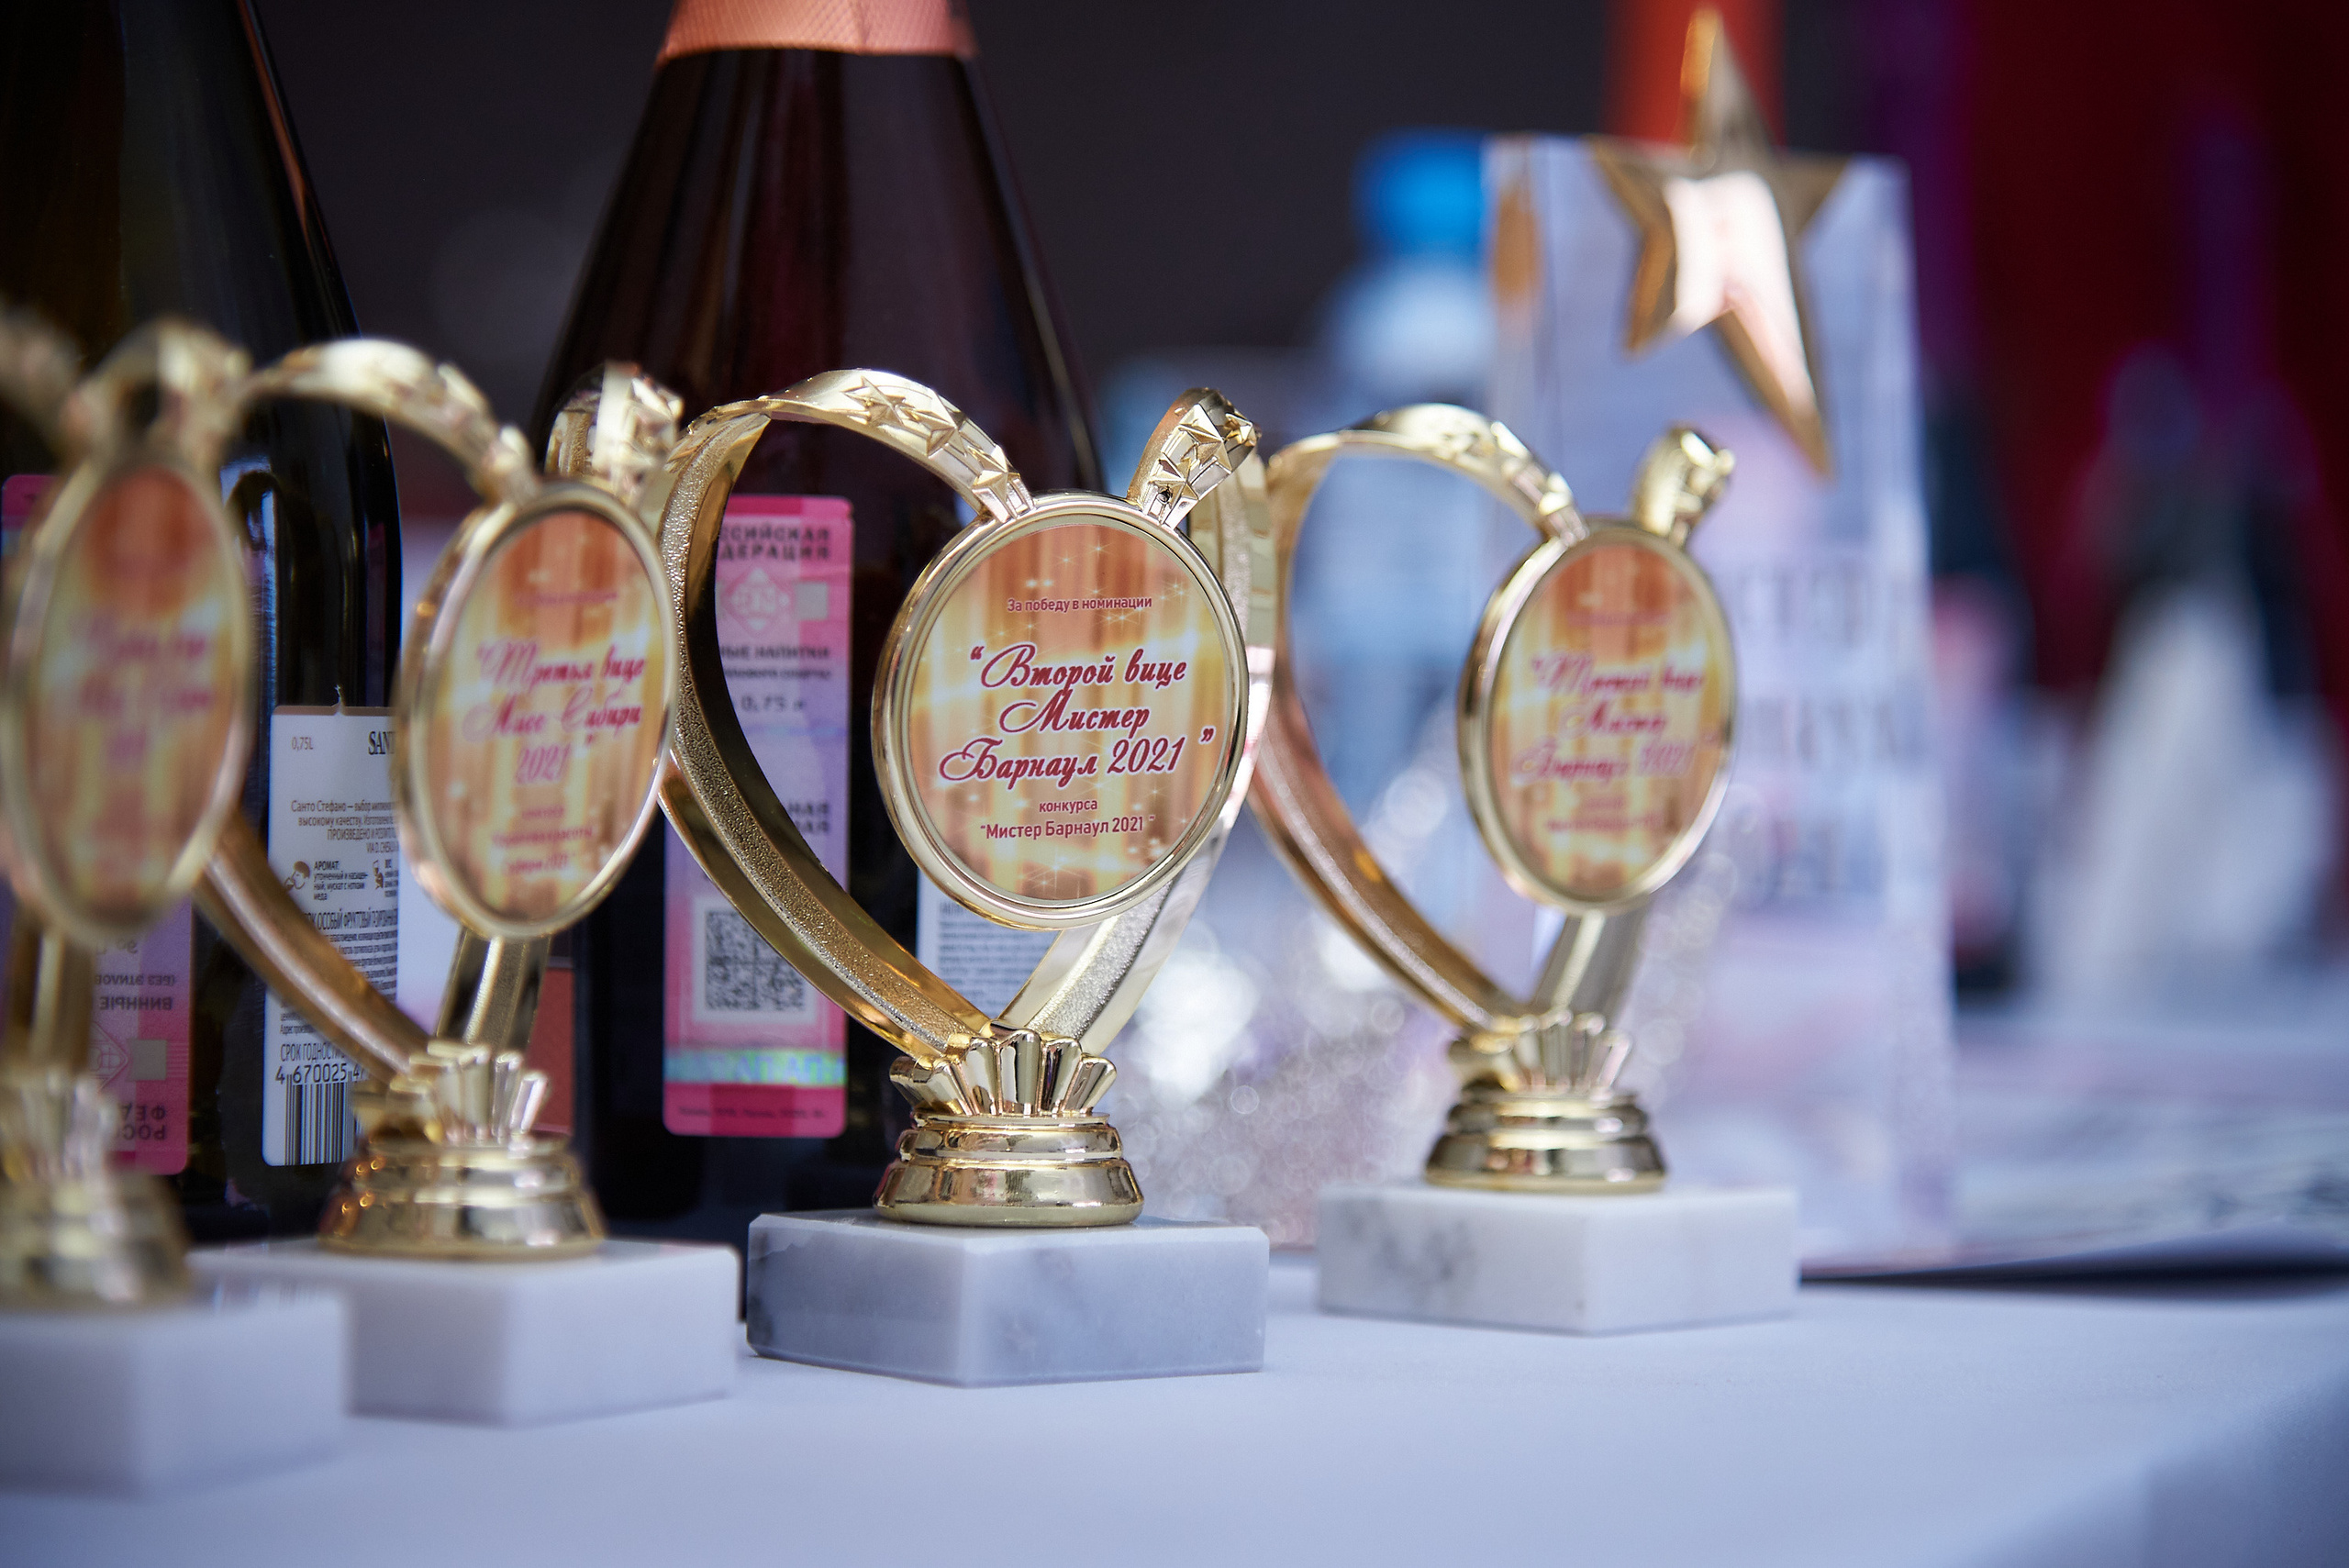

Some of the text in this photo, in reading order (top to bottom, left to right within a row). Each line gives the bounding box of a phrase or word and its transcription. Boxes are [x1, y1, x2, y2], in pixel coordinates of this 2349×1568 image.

[718, 523, 830, 542] ССИЙСКАЯ
[1008, 597, 1152, 613] За победу в номинации
[1125, 648, 1187, 690] вице
[998, 688, 1151, 740] Мистер
[939, 737, 1099, 790] Барнаул
[1107, 736, 1186, 774] 2021
[291, 800, 316, 813] Санто
[317, 800, 346, 813] Стефано
[1039, 800, 1098, 814] конкурса
[298, 816, 334, 828] высокому
[1045, 820, 1109, 839] Барнаул
[1111, 816, 1144, 833] 2021
[95, 973, 144, 986] ЭТИЛОВ
[99, 996, 173, 1011] ВИННЫЕ
[280, 1042, 302, 1062] СРОК
[117, 1103, 167, 1121] ФЕД
[118, 1124, 167, 1141] РОС
